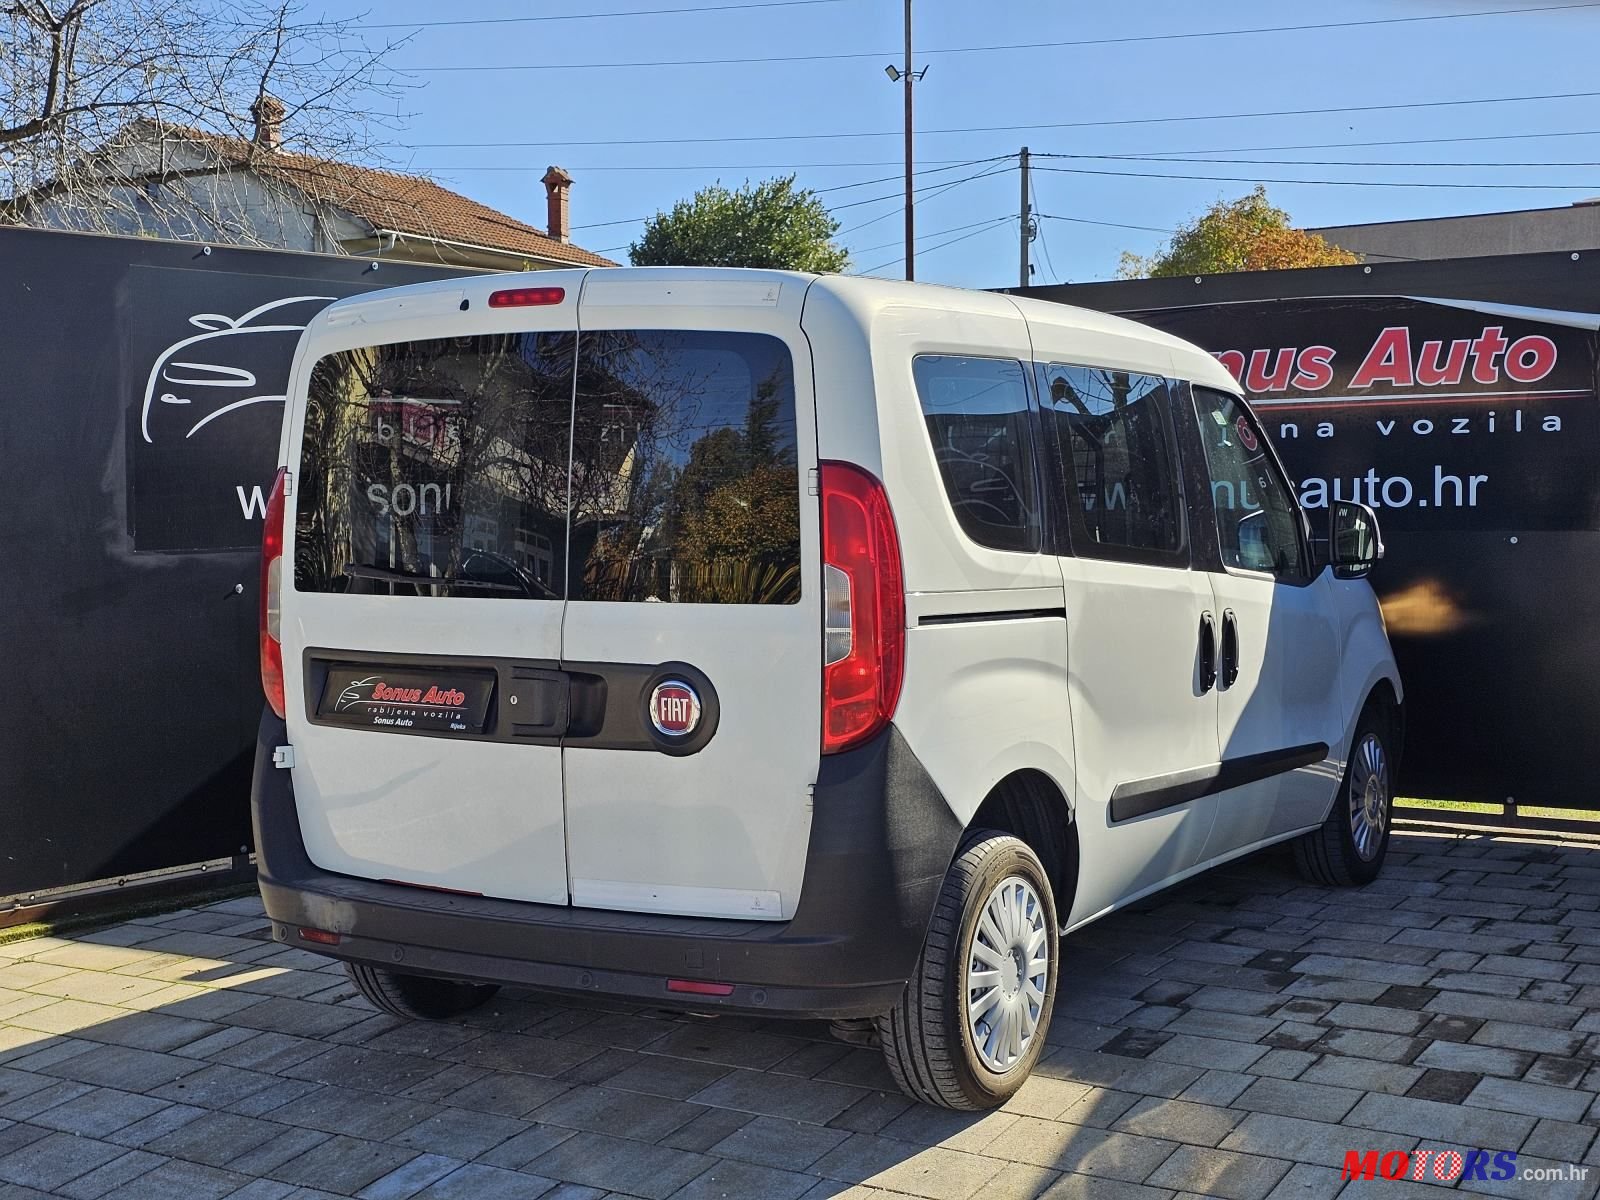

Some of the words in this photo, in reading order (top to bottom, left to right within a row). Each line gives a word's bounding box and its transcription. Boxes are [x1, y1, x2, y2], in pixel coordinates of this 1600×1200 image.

[1348, 326, 1557, 389] Auto
[1376, 410, 1562, 436] vozila
[372, 682, 422, 703] Sonus
[422, 685, 465, 706] Auto
[367, 707, 416, 716] rabljena
[423, 711, 461, 720] vozila
[373, 716, 395, 725] Sonus
[395, 717, 413, 727] Auto
[661, 697, 689, 722] FIAT
